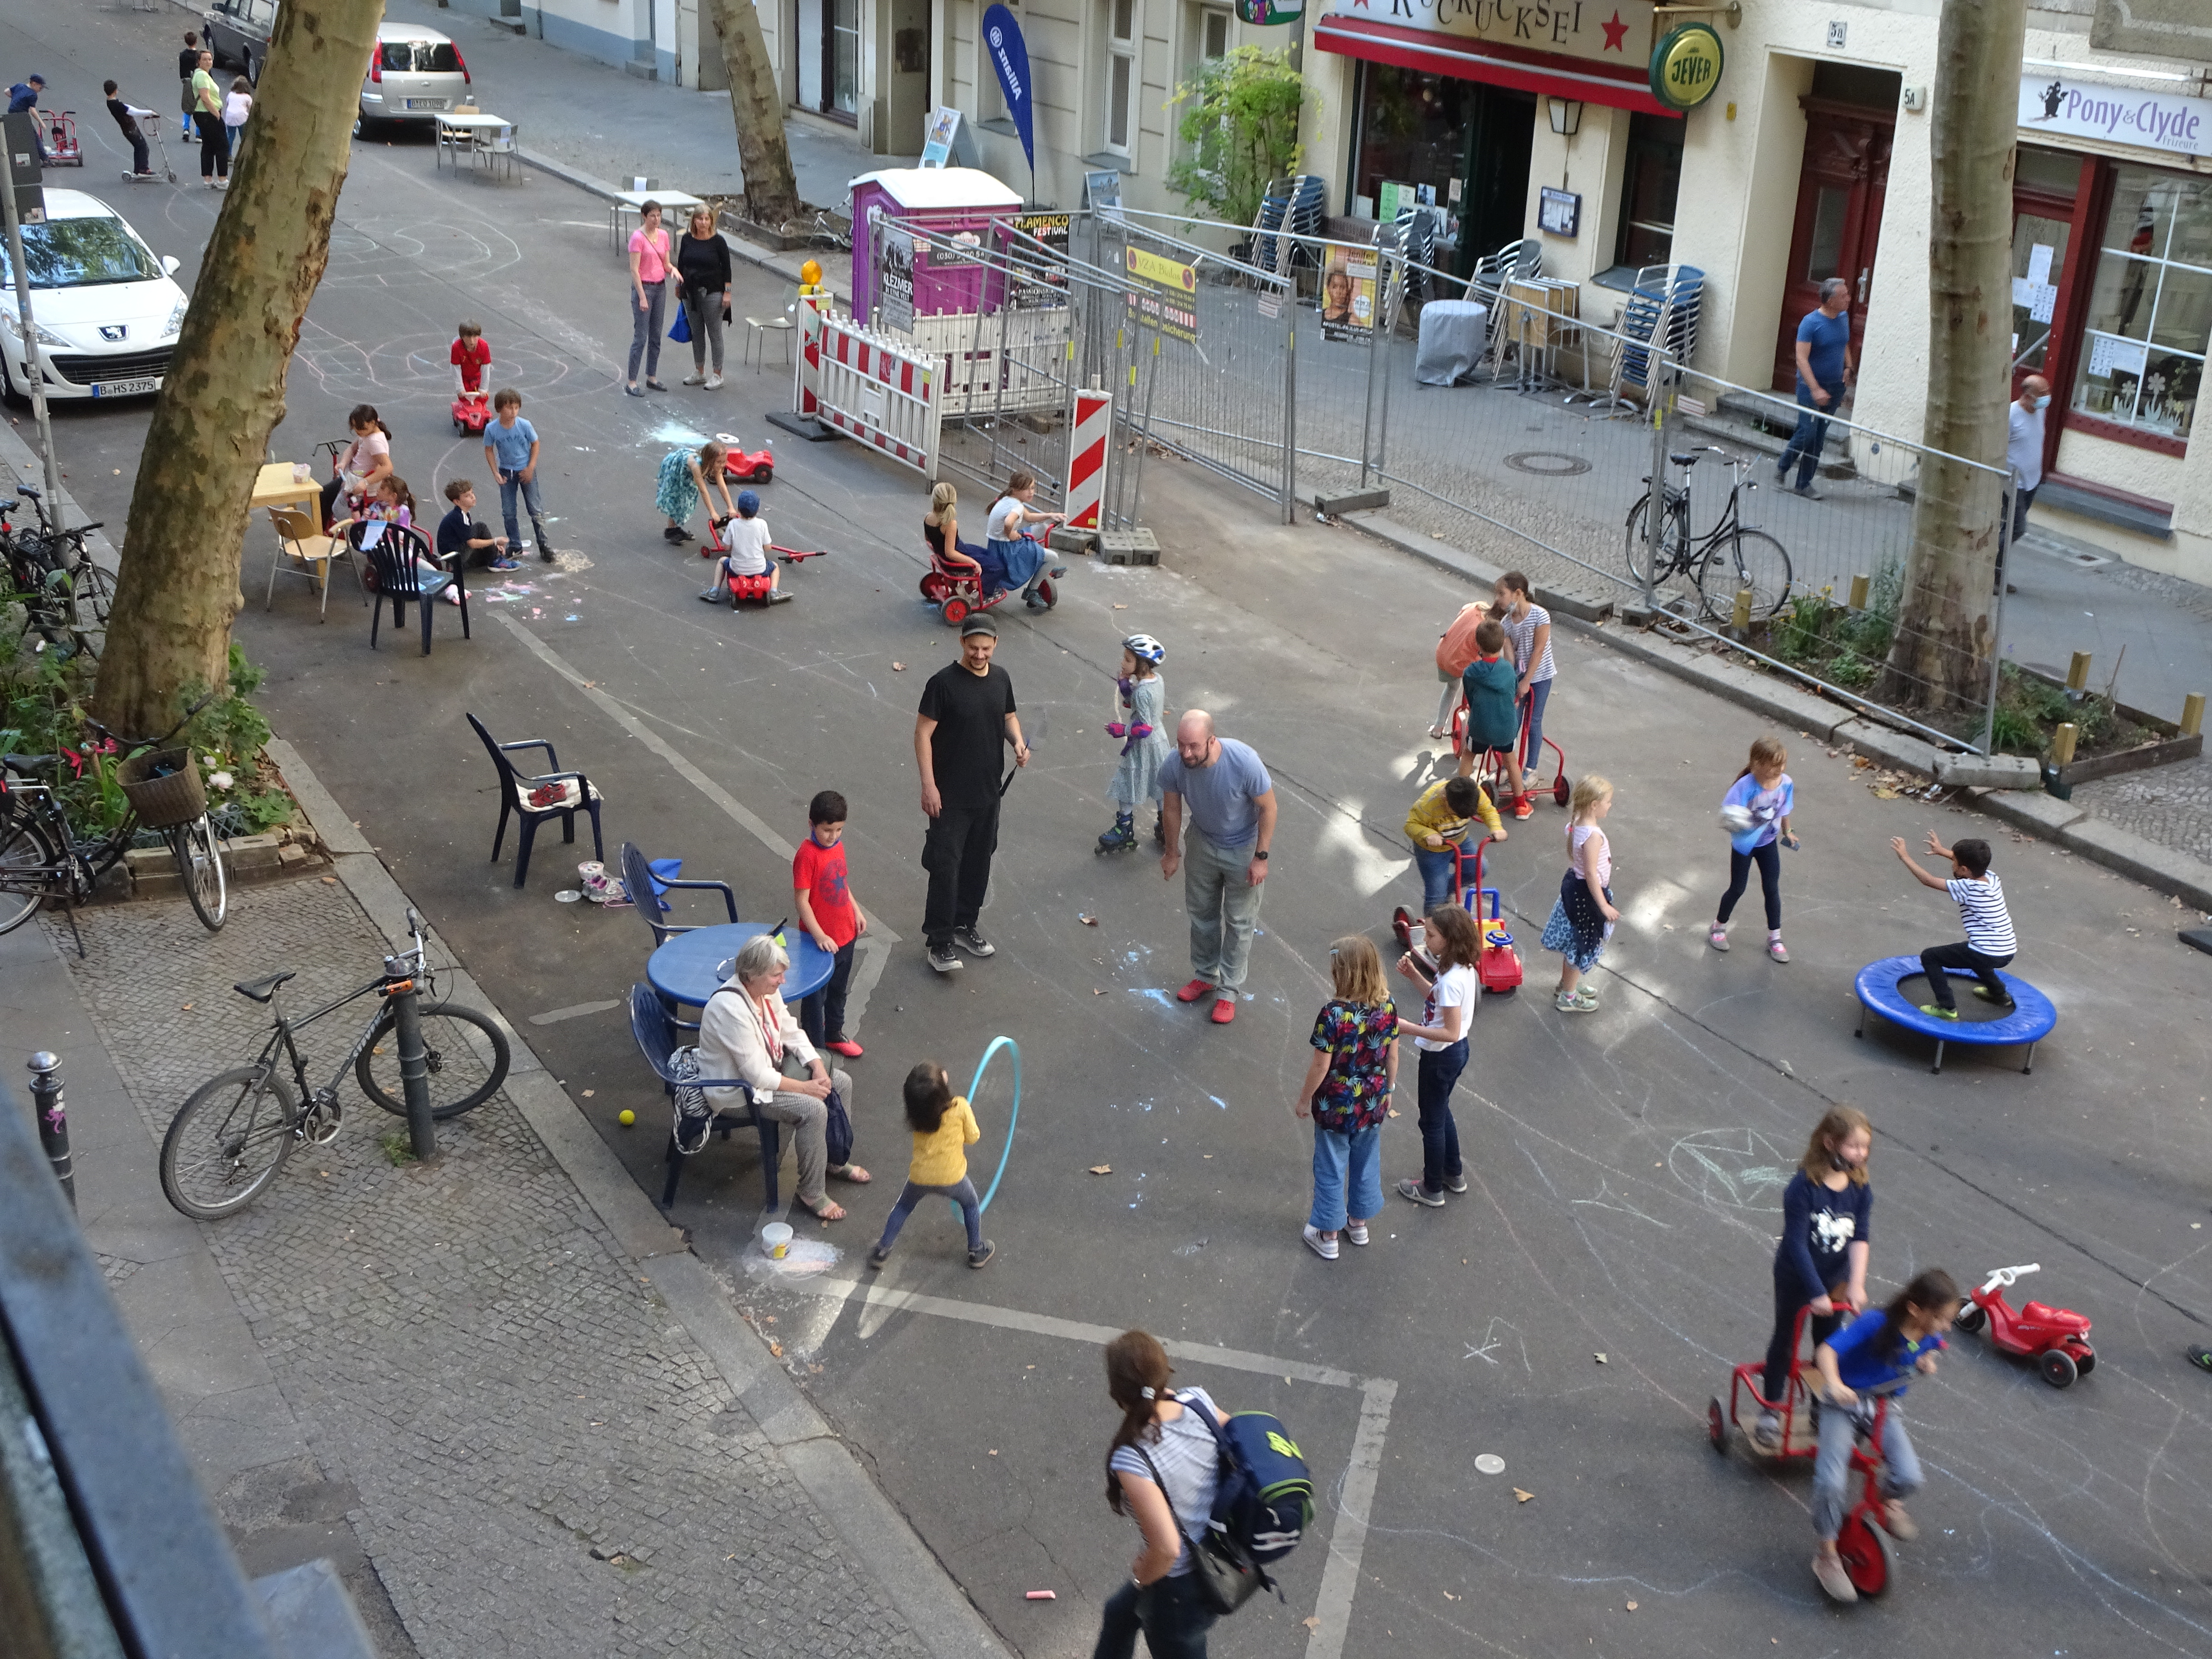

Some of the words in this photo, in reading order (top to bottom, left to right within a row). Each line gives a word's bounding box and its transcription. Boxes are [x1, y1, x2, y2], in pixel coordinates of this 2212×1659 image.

[1390, 0, 1580, 45] CUCKSEI
[1672, 56, 1711, 85] JEVER
[1904, 88, 1915, 105] 5A
[1015, 214, 1069, 229] FLAMENCO
[1033, 225, 1068, 237] FESTIVAL
[883, 271, 913, 296] KLEZMER
[100, 386, 107, 395] B
[113, 384, 127, 394] HS
[129, 381, 153, 392] 2375
